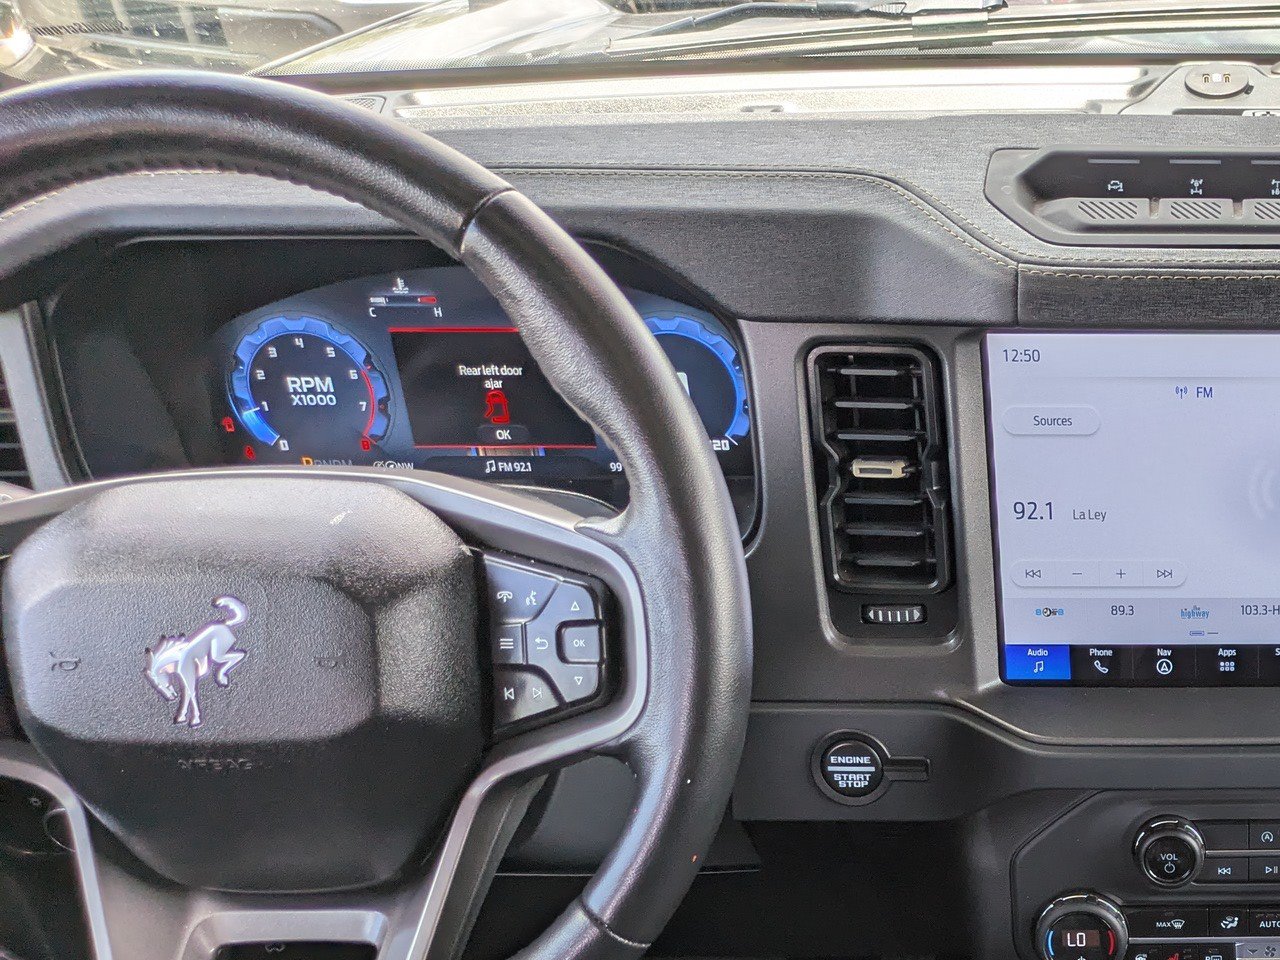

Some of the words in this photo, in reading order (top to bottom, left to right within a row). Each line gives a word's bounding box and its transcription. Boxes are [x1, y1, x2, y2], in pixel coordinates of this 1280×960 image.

[369, 307, 376, 317] C
[434, 307, 442, 317] H
[294, 338, 304, 348] 4
[268, 347, 277, 358] 3
[326, 347, 335, 358] 5
[1002, 348, 1041, 363] 12:50
[256, 370, 265, 380] 2
[349, 369, 358, 380] 6
[459, 365, 481, 376] Rear
[481, 365, 500, 376] left
[500, 365, 523, 376] door
[287, 377, 334, 392] RPM
[485, 379, 503, 390] ajar
[1196, 387, 1213, 398] FM
[292, 394, 336, 406] X1000
[262, 401, 269, 411] 1
[359, 401, 366, 412] 7
[1033, 415, 1073, 427] Sources
[496, 430, 511, 440] OK
[710, 439, 730, 451] 20
[499, 462, 513, 472] FM
[513, 462, 532, 472] 92.1
[1013, 501, 1055, 520] 92.1
[1072, 509, 1087, 520] La
[1088, 509, 1107, 523] Ley
[1110, 605, 1135, 616] 89.3
[1180, 608, 1210, 620] highway
[573, 639, 585, 647] OK
[1027, 648, 1049, 657] Audio
[1089, 648, 1113, 657] Phone
[1157, 648, 1172, 657] Nav
[1217, 648, 1237, 658] Apps
[830, 756, 871, 764] ENGINE
[834, 773, 871, 781] START
[839, 780, 869, 788] STOP
[1160, 853, 1178, 861] VOL
[1067, 932, 1086, 947] LO
